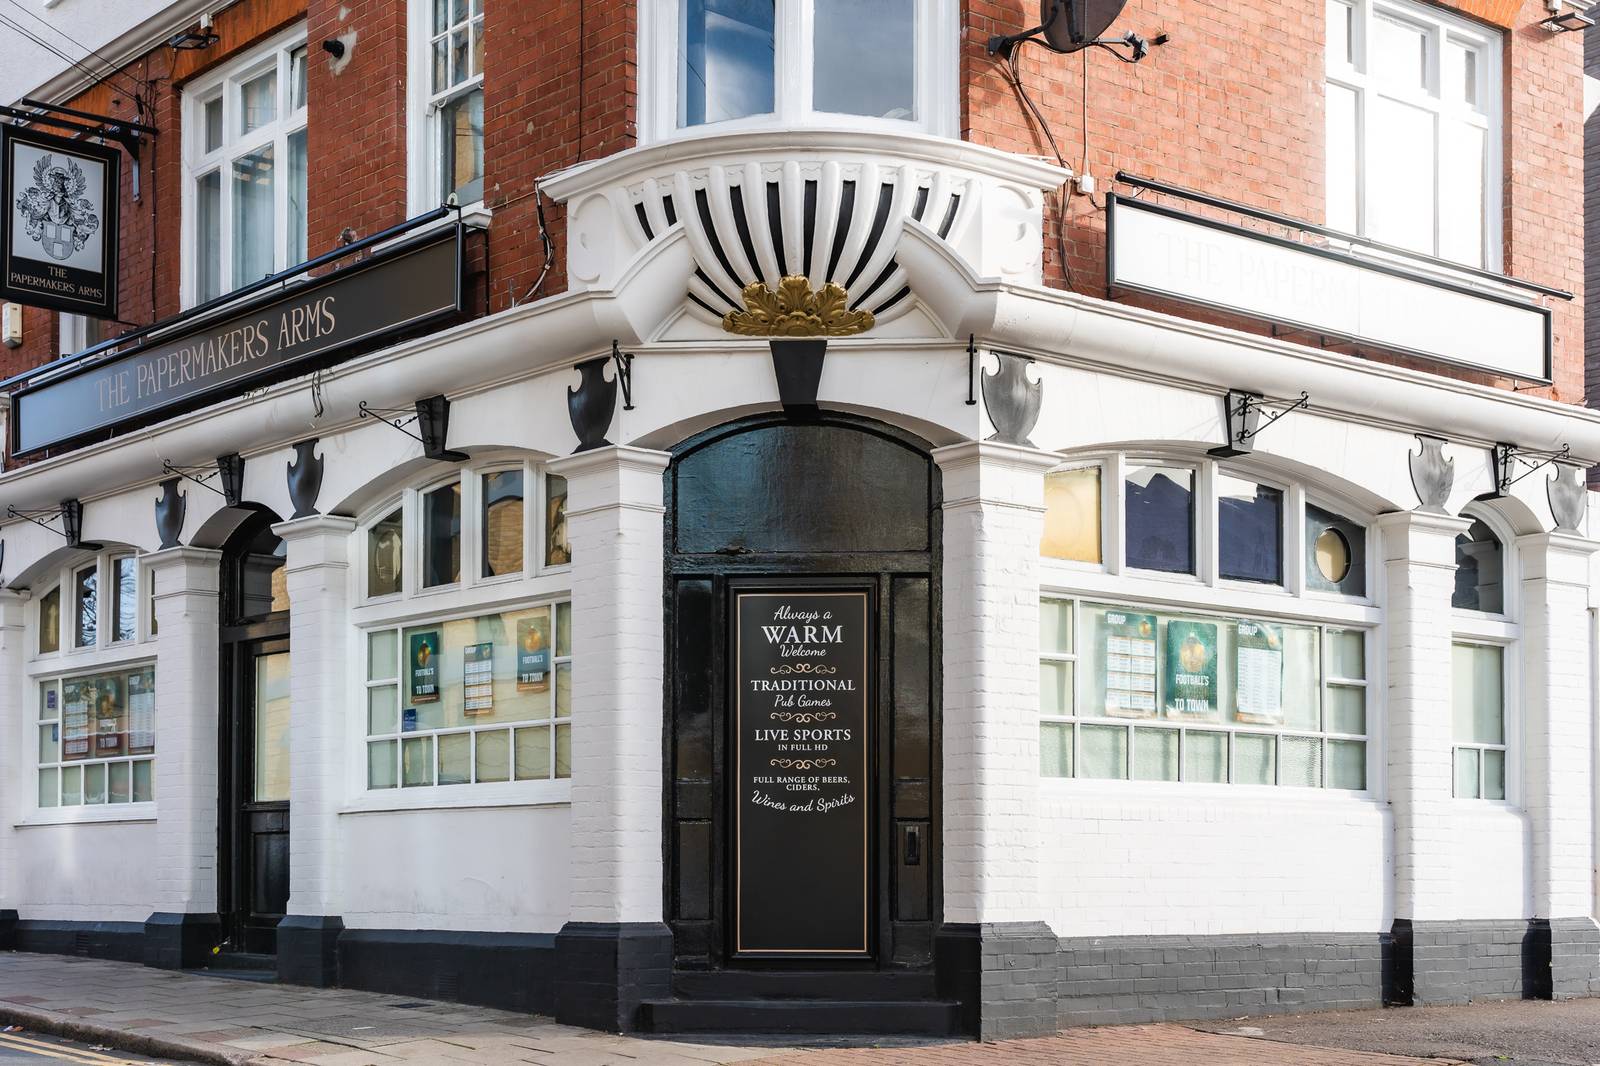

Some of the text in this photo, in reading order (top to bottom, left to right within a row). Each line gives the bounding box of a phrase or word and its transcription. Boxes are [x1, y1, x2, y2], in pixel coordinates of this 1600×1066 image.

[48, 265, 68, 279] THE
[10, 271, 103, 299] PAPERMAKERS ARMS
[95, 296, 337, 412] THE PAPERMAKERS ARMS
[773, 605, 832, 623] Always a
[761, 625, 844, 644] WARM
[780, 643, 827, 658] Welcome
[751, 679, 856, 692] TRADITIONAL
[774, 694, 832, 708] Pub Games
[1175, 698, 1209, 712] TO TOWN
[755, 729, 851, 741] LIVE SPORTS
[753, 776, 775, 784] FULL
[777, 776, 806, 784] RANGE
[808, 776, 821, 784] OF
[752, 790, 856, 814] Wines and Spirits
